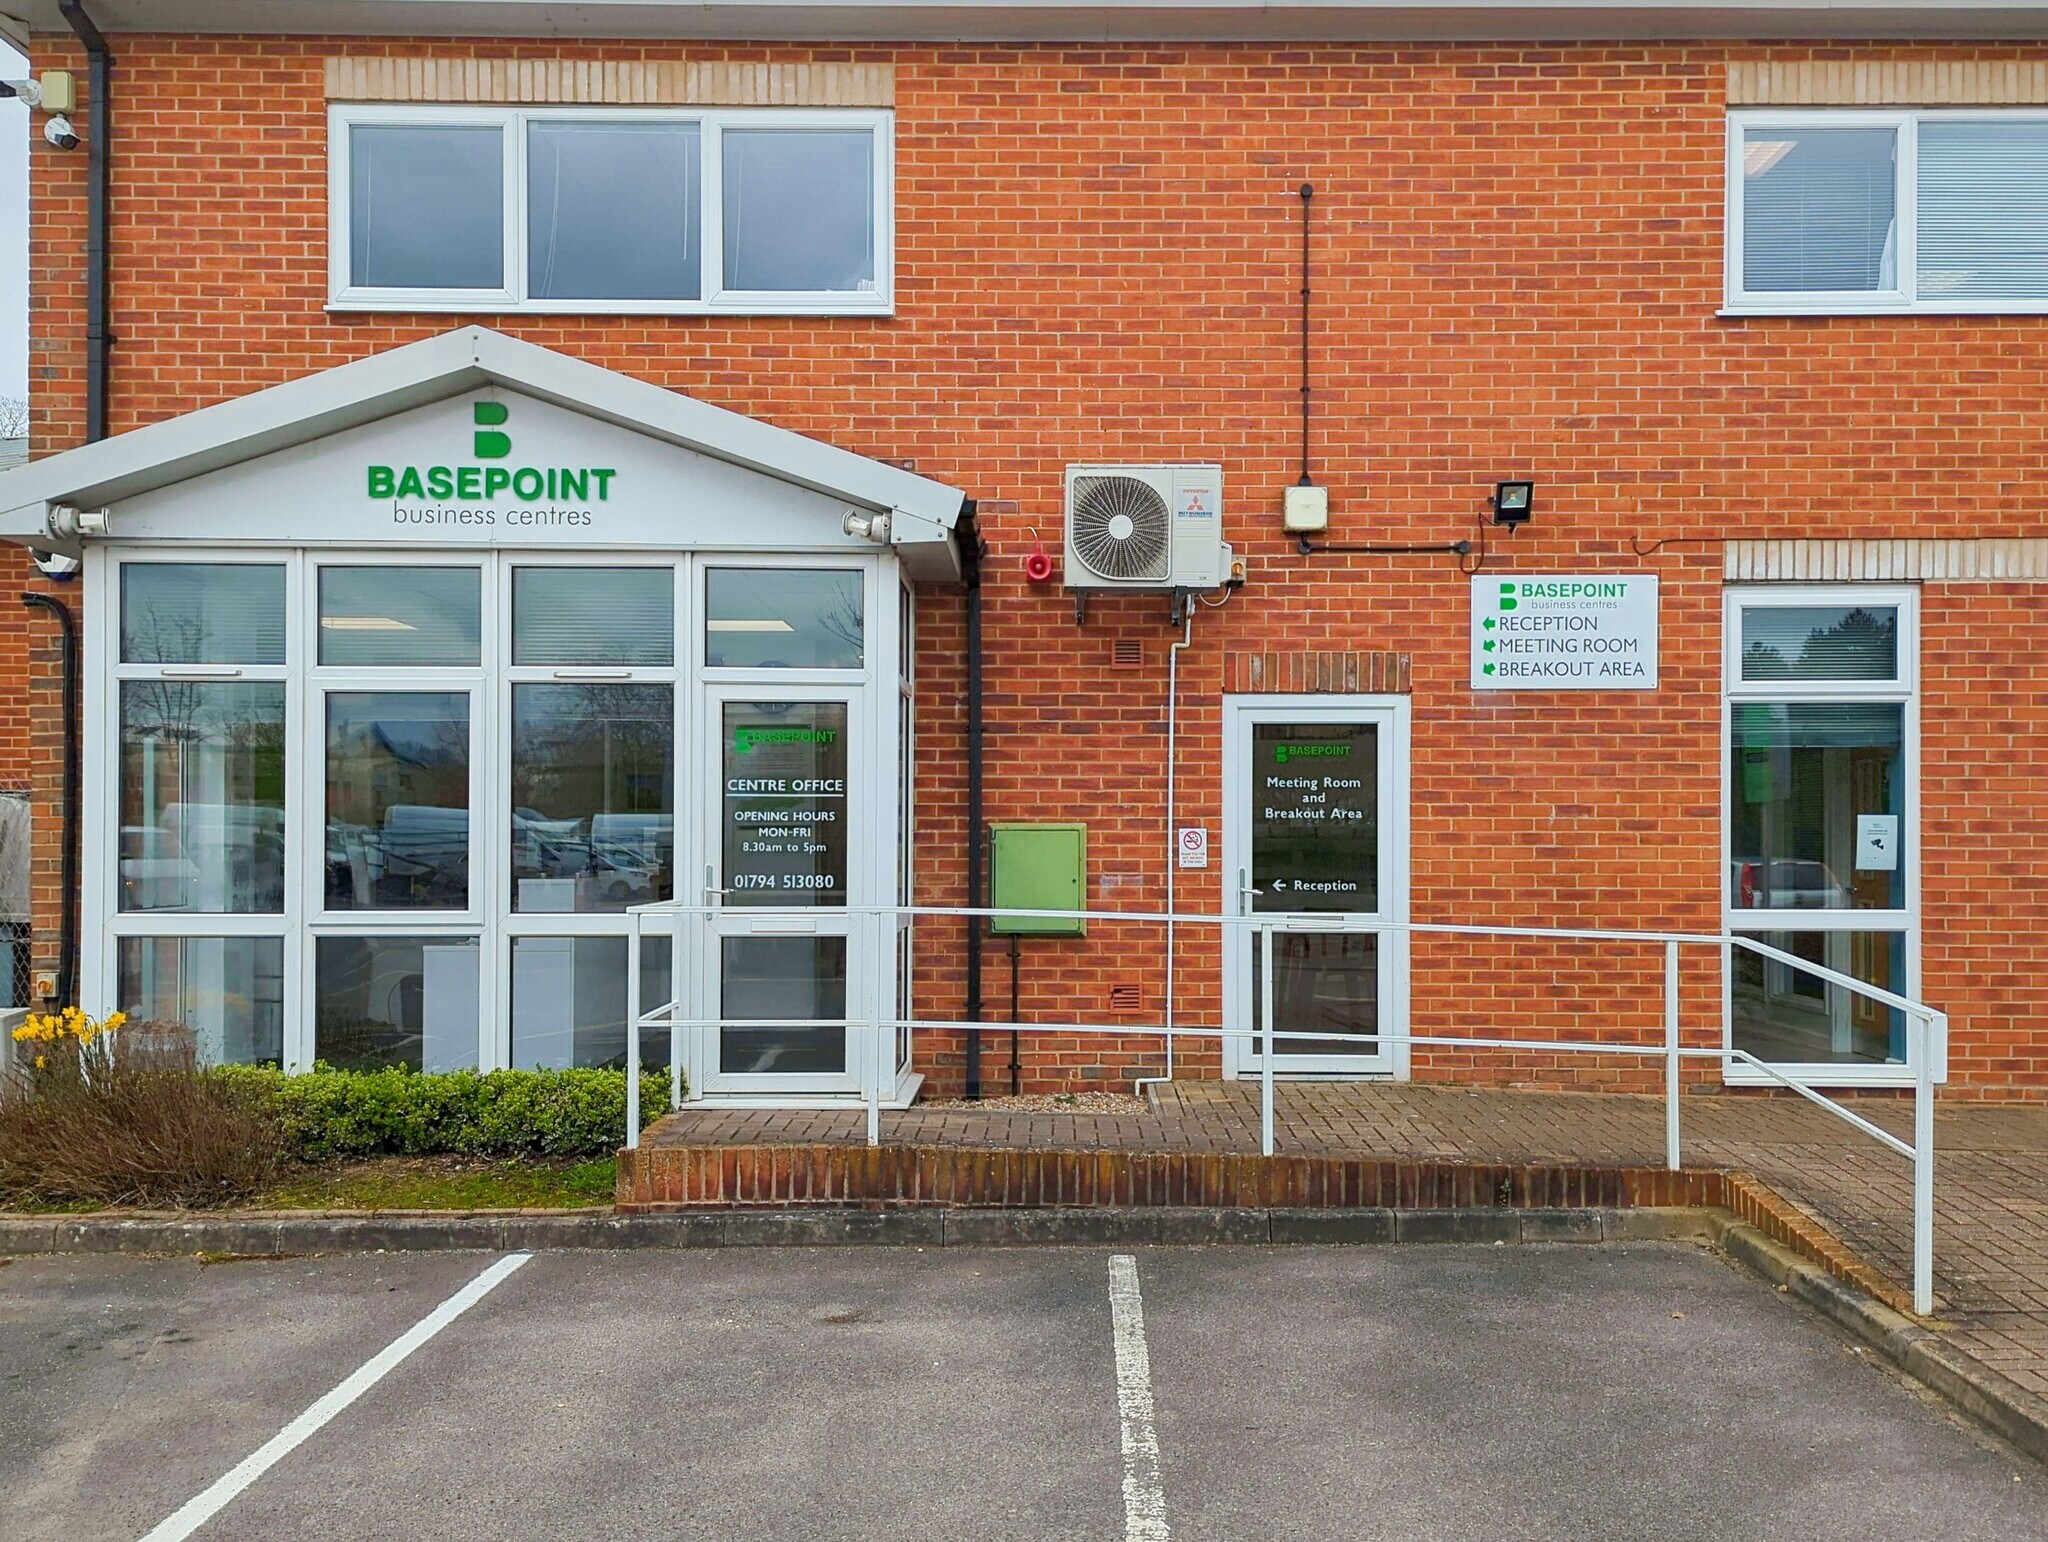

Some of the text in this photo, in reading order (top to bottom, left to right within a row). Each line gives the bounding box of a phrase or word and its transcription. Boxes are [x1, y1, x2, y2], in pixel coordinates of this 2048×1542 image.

[368, 466, 616, 502] BASEPOINT
[394, 500, 592, 525] business centres
[1521, 583, 1628, 597] BASEPOINT
[1531, 599, 1618, 609] business centres
[1499, 616, 1598, 631] RECEPTION
[1499, 638, 1638, 653] MEETING ROOM
[1499, 661, 1646, 676] BREAKOUT AREA
[752, 730, 836, 742] BASEPOINT
[1289, 746, 1351, 755] BASEPOINT
[727, 779, 843, 791] CENTRE OFFICE
[1267, 777, 1361, 790] Meeting Room
[1302, 792, 1326, 803] and
[734, 811, 836, 821] OPENING HOURS
[1265, 807, 1363, 819] Breakout Area
[758, 827, 811, 837] MON-FRI
[742, 842, 827, 854] 8.30am to 5pm
[734, 874, 834, 888] 01794 513080
[1294, 879, 1357, 893] Reception
